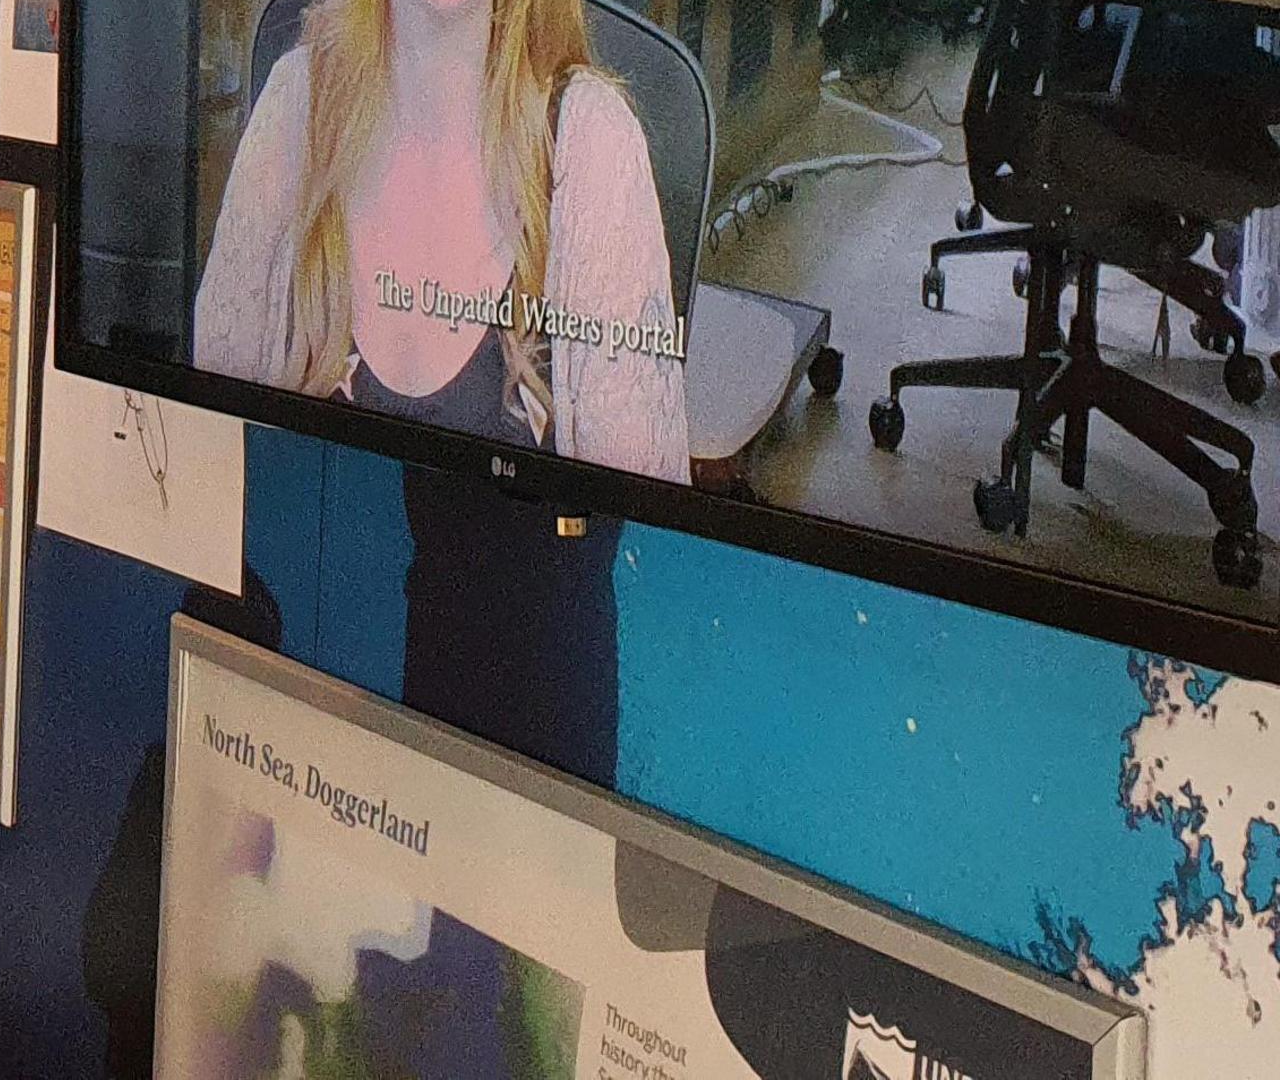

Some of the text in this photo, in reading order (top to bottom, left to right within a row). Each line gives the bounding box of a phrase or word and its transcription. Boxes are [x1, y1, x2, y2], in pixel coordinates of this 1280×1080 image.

[374, 270, 413, 309] The
[521, 291, 603, 344] Waters
[609, 315, 686, 358] portal
[502, 461, 516, 478] LG
[202, 714, 430, 857] North Sea, Doggerland
[600, 1033, 651, 1080] history
[605, 1002, 687, 1068] Throughout
